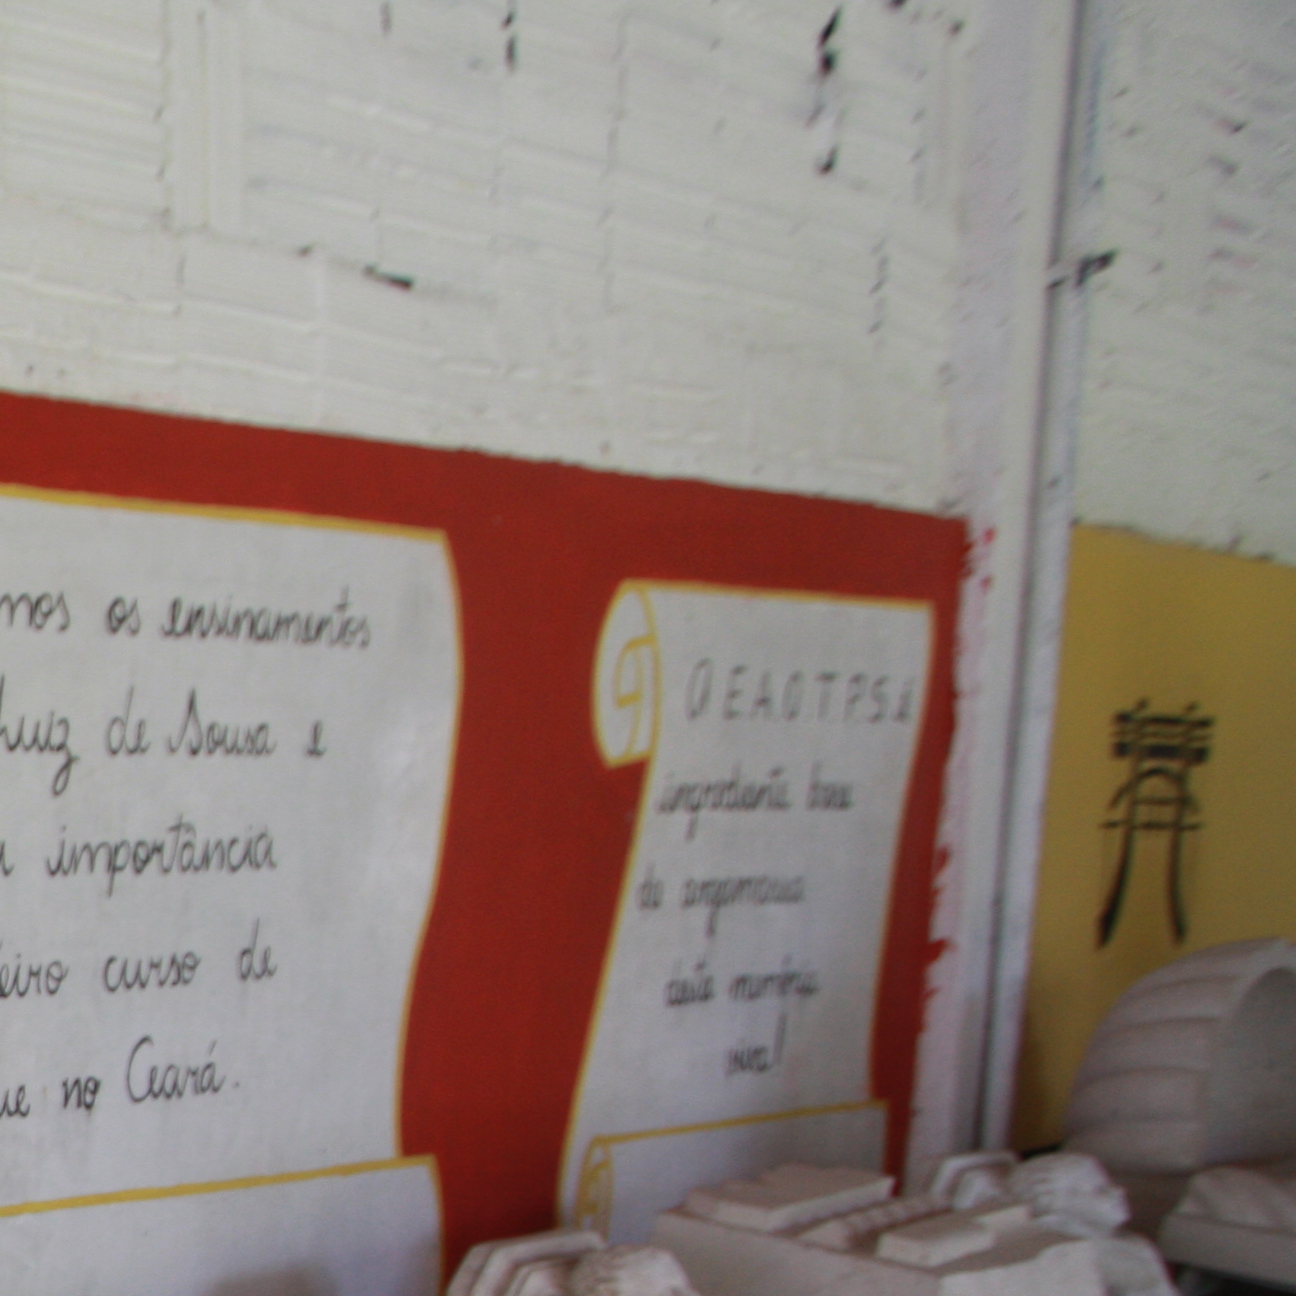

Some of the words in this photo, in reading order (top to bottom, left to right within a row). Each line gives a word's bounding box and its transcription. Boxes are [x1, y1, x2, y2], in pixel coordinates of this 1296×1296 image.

[104, 596, 141, 636] os
[105, 686, 150, 758] de
[166, 688, 275, 758] Sousa
[304, 721, 326, 759] e
[45, 815, 277, 897] importância
[101, 951, 201, 994] curso
[237, 919, 277, 984] de
[61, 1074, 101, 1109] no
[125, 1034, 241, 1104] Ceará.
